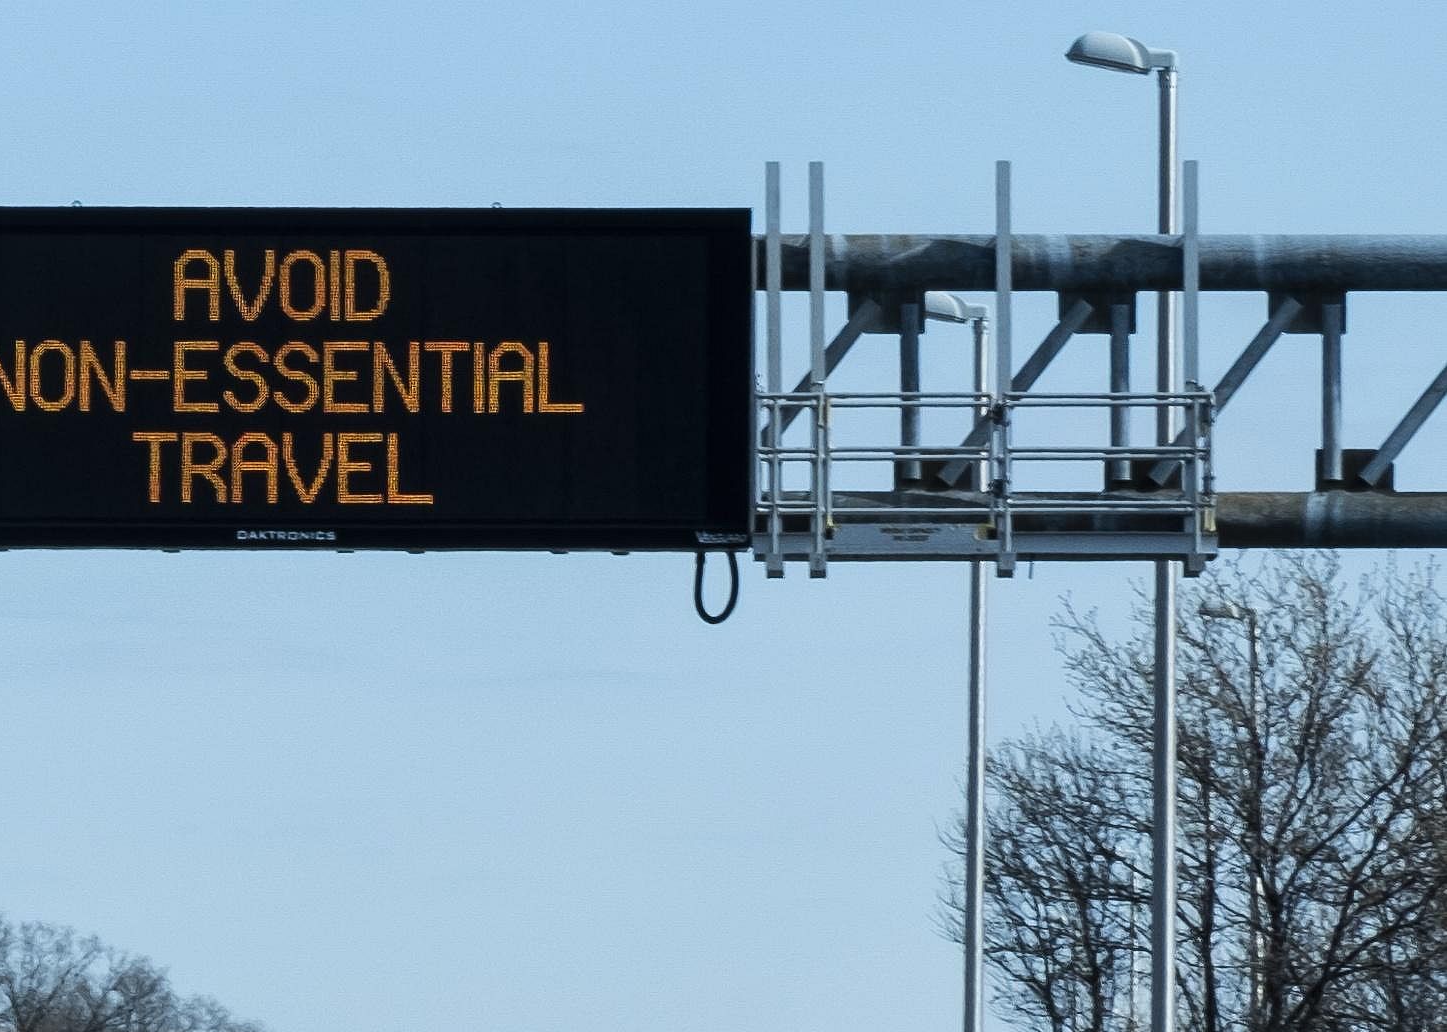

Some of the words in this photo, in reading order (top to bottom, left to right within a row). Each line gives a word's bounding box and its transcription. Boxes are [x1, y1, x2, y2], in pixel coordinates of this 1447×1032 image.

[173, 249, 391, 322] AVOID
[132, 431, 435, 505] TRAVEL
[236, 530, 336, 541] DAKTRONICS
